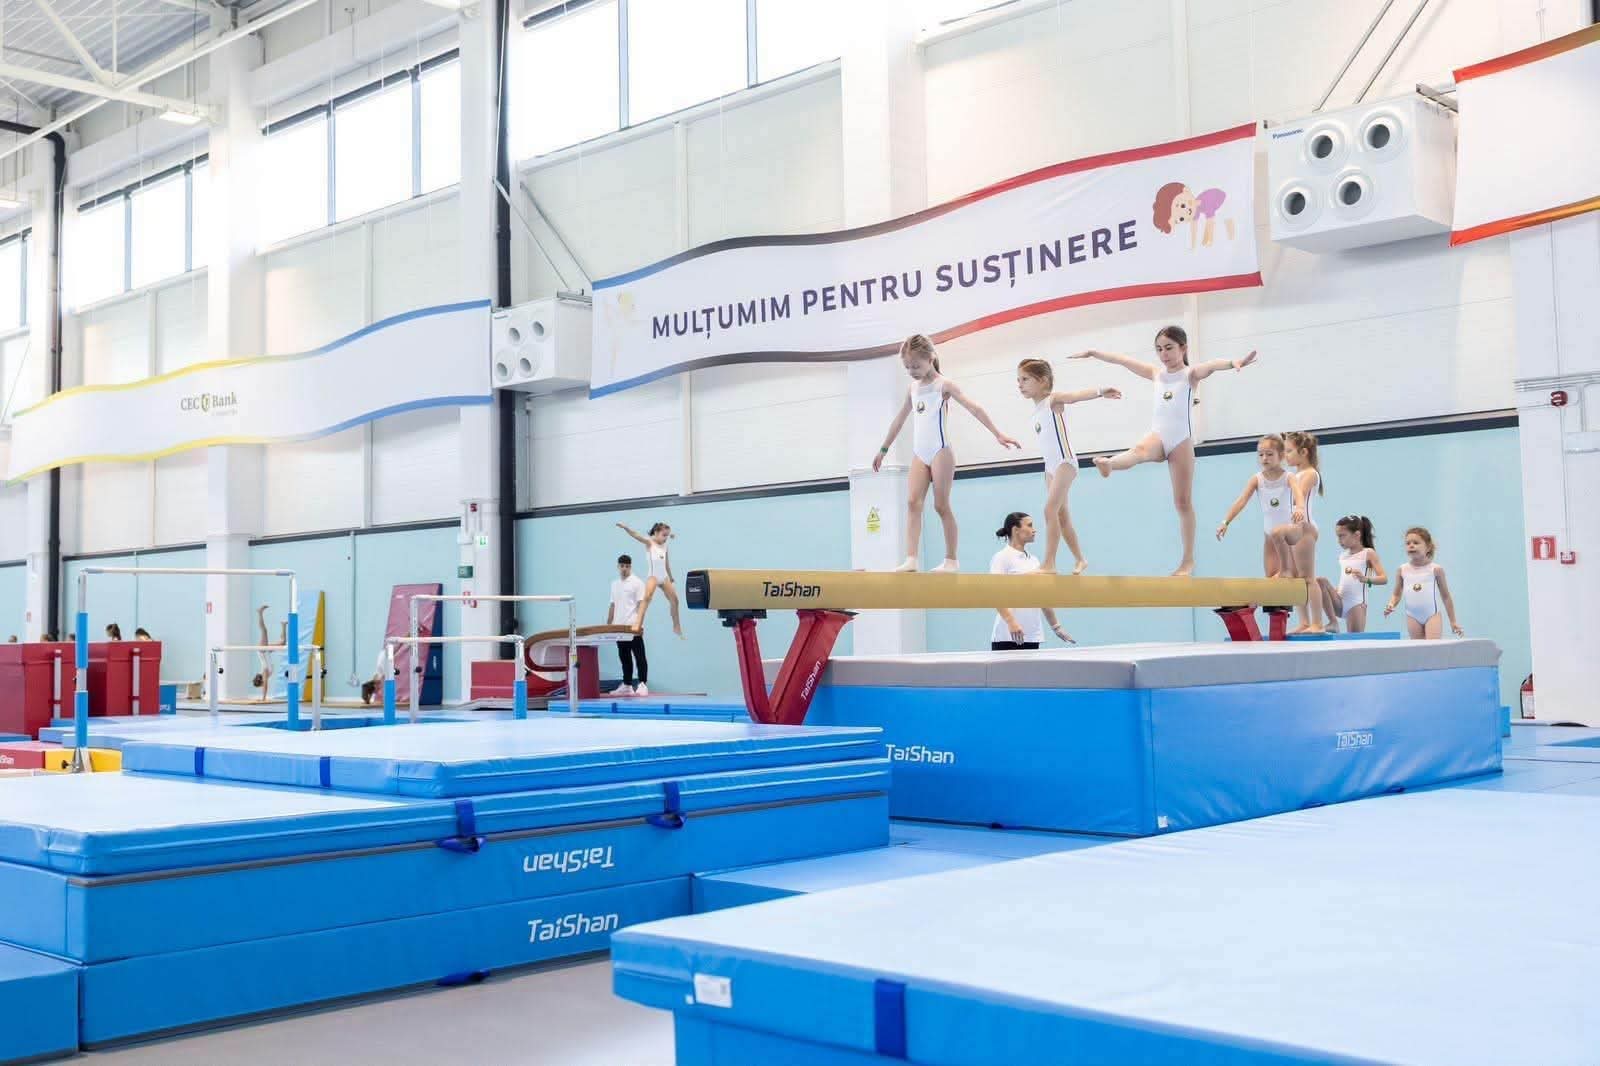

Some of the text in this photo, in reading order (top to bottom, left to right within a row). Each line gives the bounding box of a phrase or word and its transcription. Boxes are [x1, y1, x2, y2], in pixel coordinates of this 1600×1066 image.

[652, 219, 1138, 340] MULȚUMIM PENTRU SUSȚINERE
[180, 391, 237, 410] CEC Bank
[762, 581, 821, 598] TaiShan
[800, 660, 821, 700] TaiShan
[1335, 731, 1373, 748] TaiShan
[885, 743, 955, 764] TaiShan
[523, 845, 615, 873] TaiShan
[527, 913, 619, 943] TaiShan
